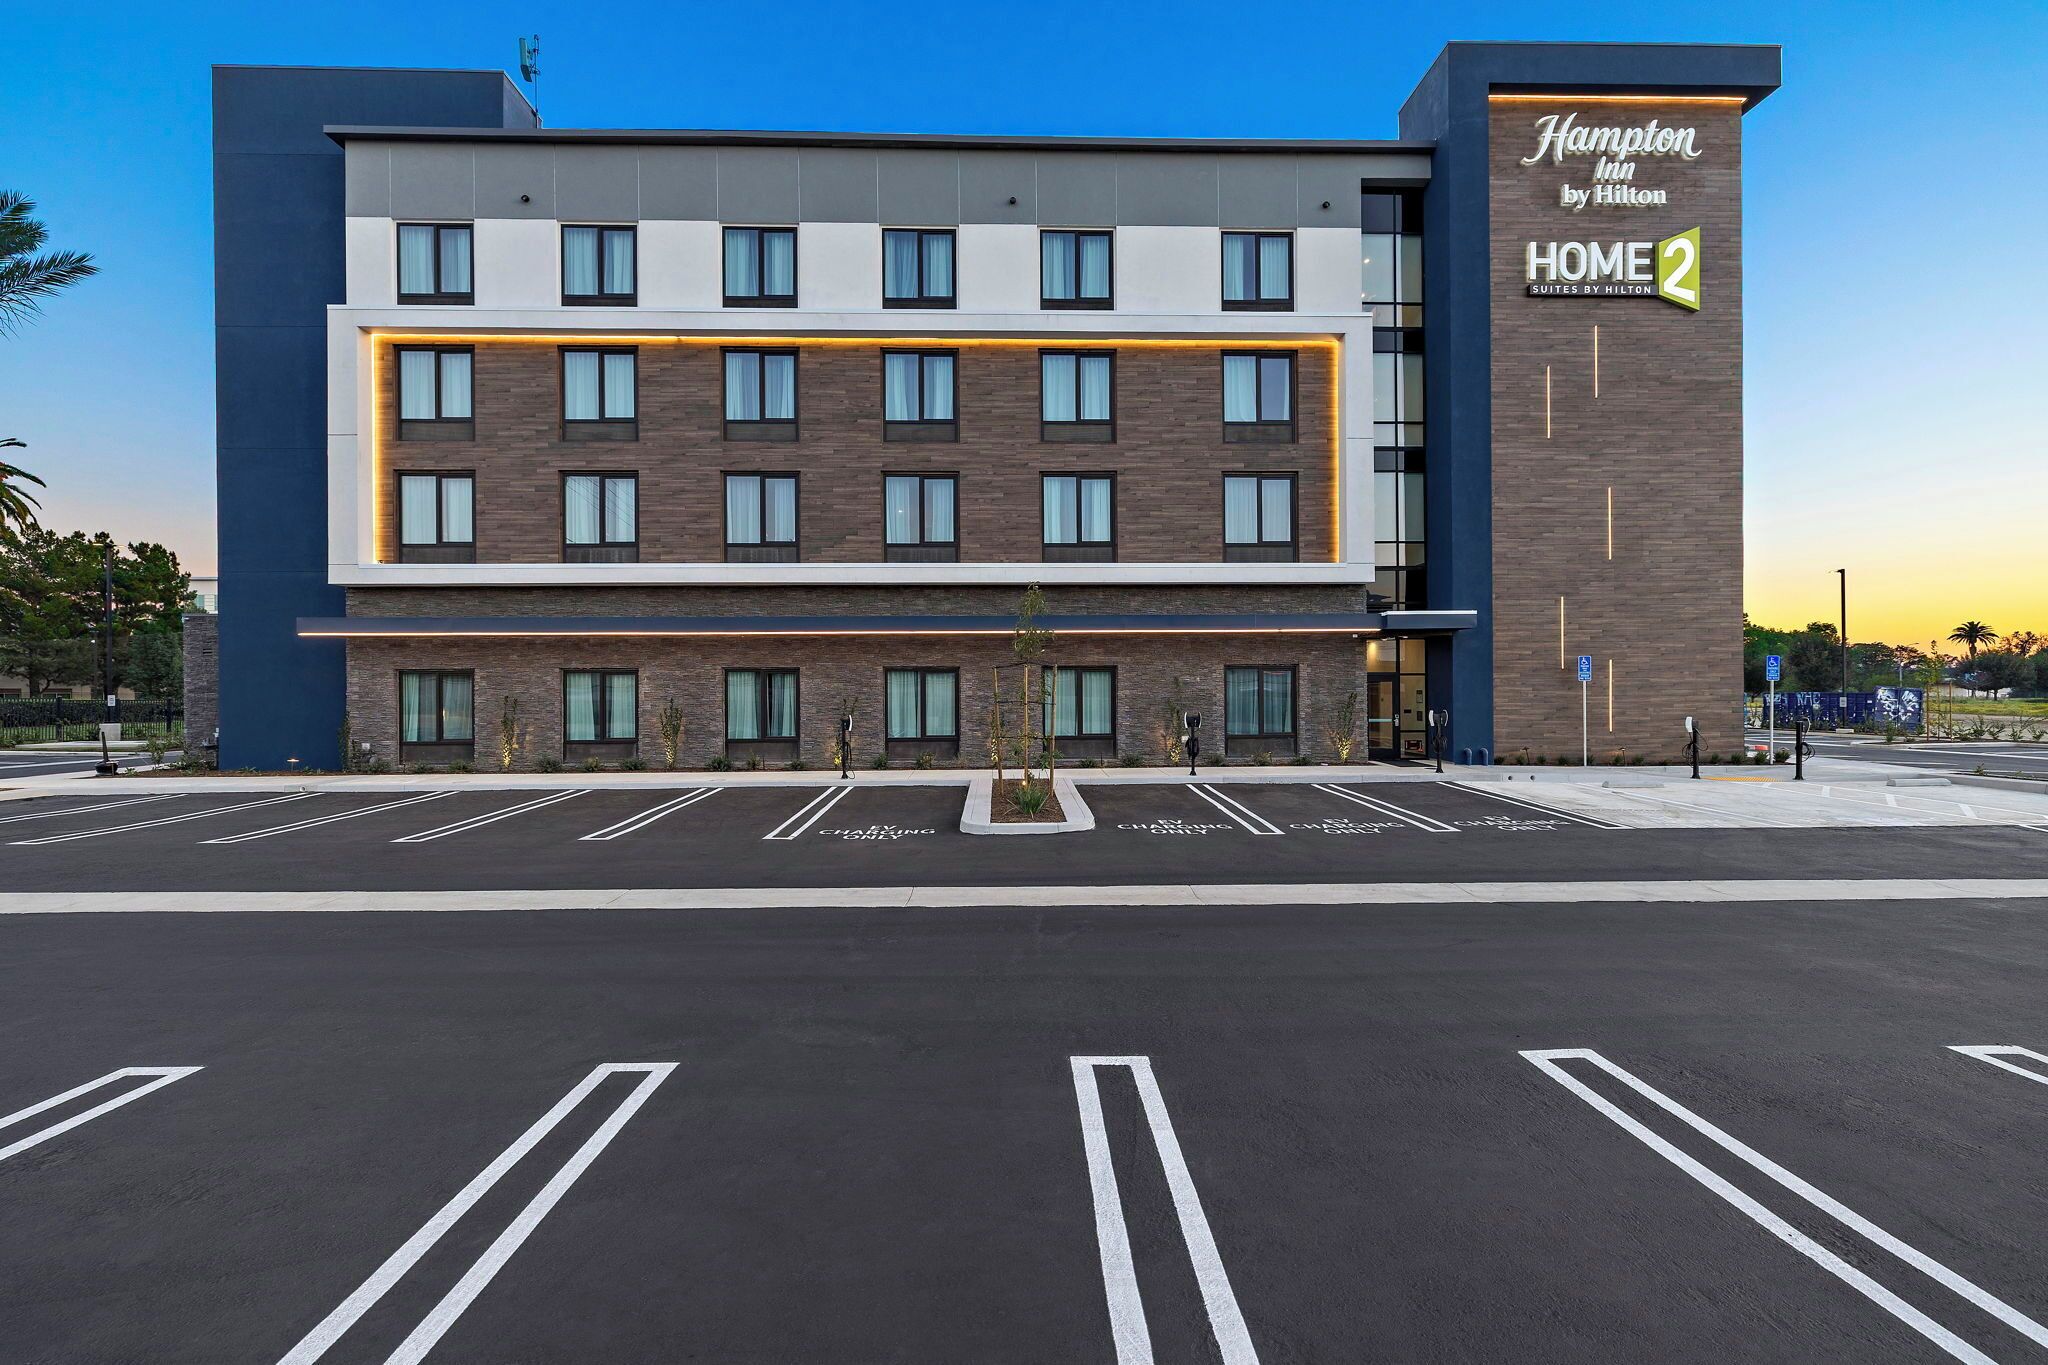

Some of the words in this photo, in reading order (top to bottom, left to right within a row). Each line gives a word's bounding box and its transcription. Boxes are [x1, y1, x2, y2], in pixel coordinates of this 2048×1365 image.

[1521, 112, 1702, 164] Hampton
[1594, 156, 1636, 181] Inn
[1562, 184, 1591, 209] by
[1595, 184, 1667, 206] Hilton
[1528, 241, 1654, 281] HOME
[1663, 237, 1696, 303] 2
[1532, 285, 1578, 294] SUITES
[1584, 285, 1600, 294] BY
[1605, 285, 1652, 294] HILTON
